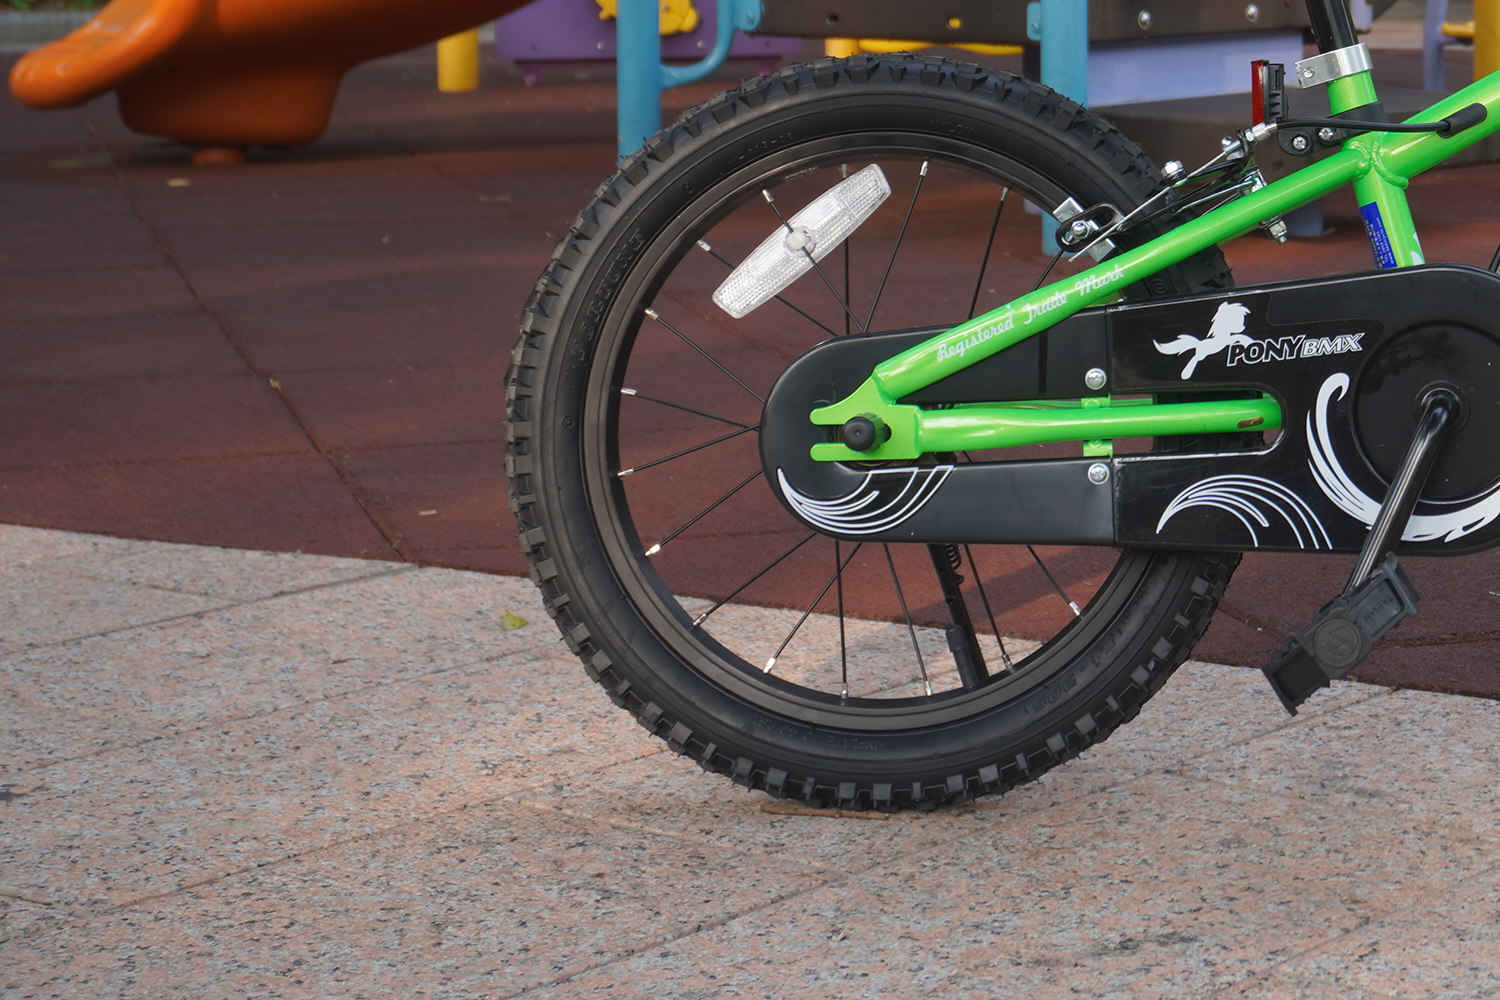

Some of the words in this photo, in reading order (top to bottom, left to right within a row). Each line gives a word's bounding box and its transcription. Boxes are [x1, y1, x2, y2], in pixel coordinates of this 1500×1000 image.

[937, 305, 1015, 361] Registered
[1021, 291, 1068, 324] Trade
[1074, 264, 1124, 296] Mark
[1226, 333, 1365, 367] PONYBMX
